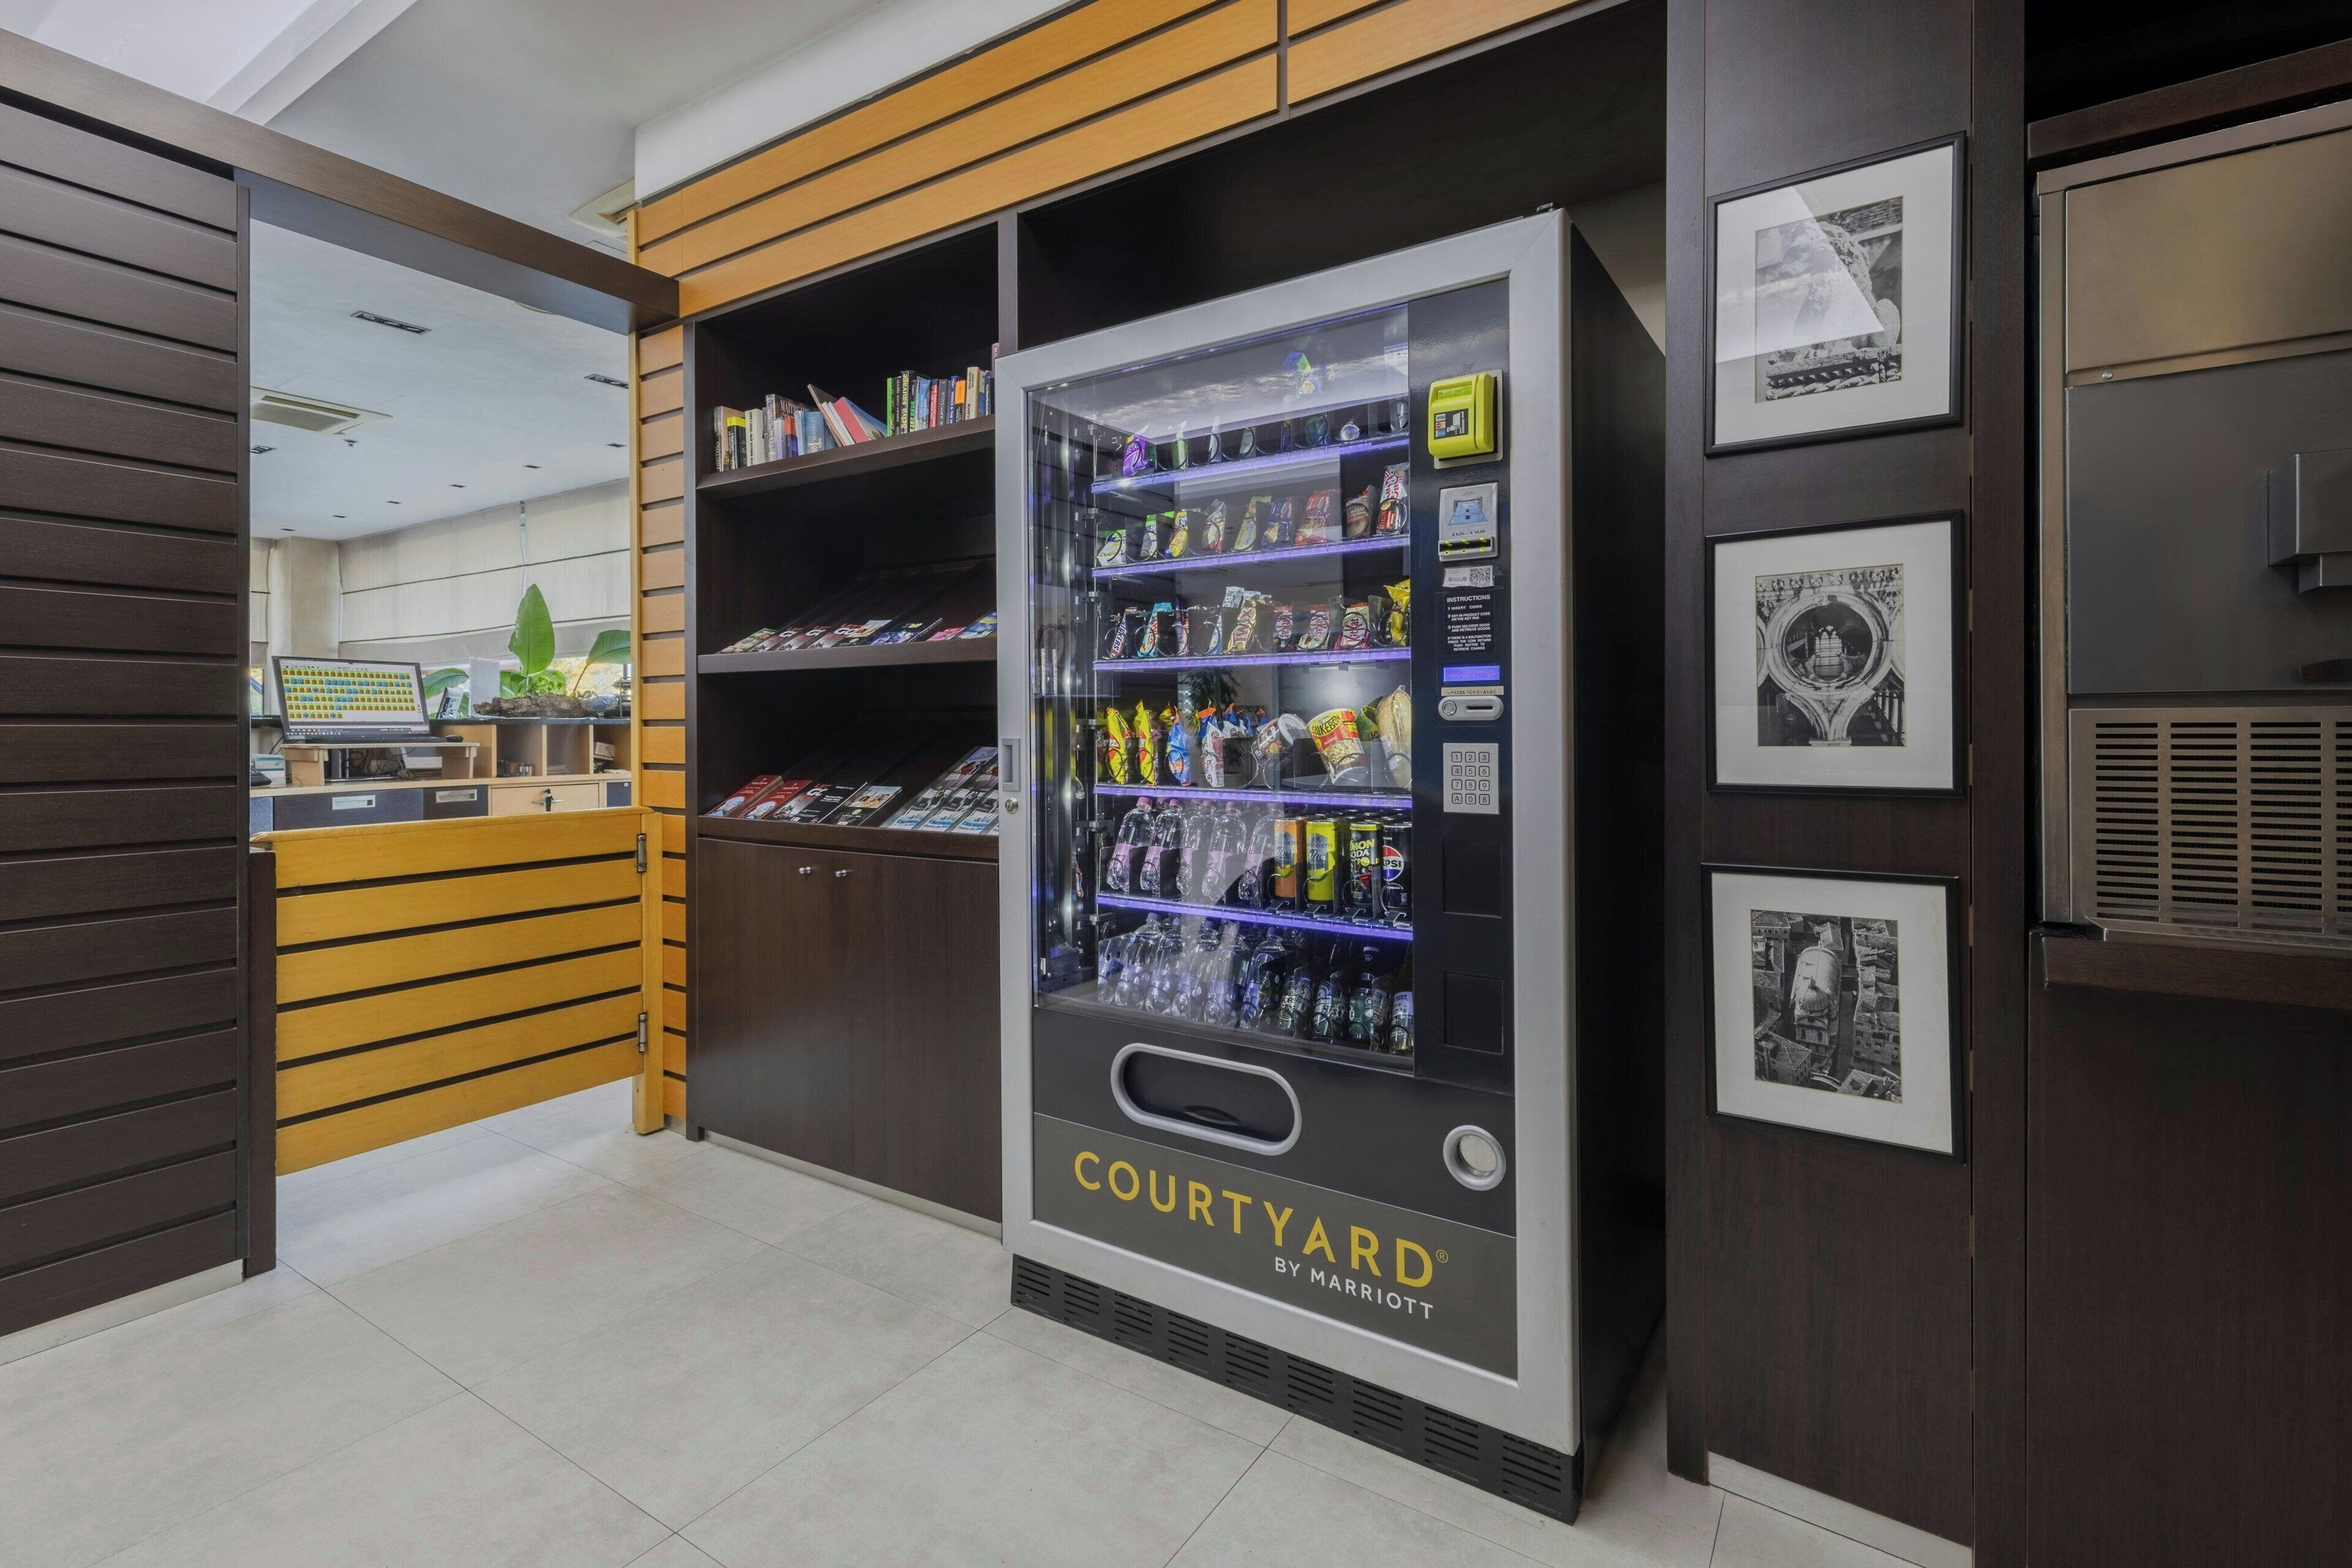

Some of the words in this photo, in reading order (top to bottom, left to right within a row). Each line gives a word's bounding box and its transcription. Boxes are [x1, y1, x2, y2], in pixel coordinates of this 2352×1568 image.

[1345, 618, 1367, 643] KitKat
[1312, 714, 1341, 736] SAIKEBON
[1324, 736, 1338, 745] MANZO
[1074, 1152, 1433, 1287] COURTYARD
[1275, 1257, 1300, 1277] BY
[1311, 1270, 1433, 1319] MARRIOTT
